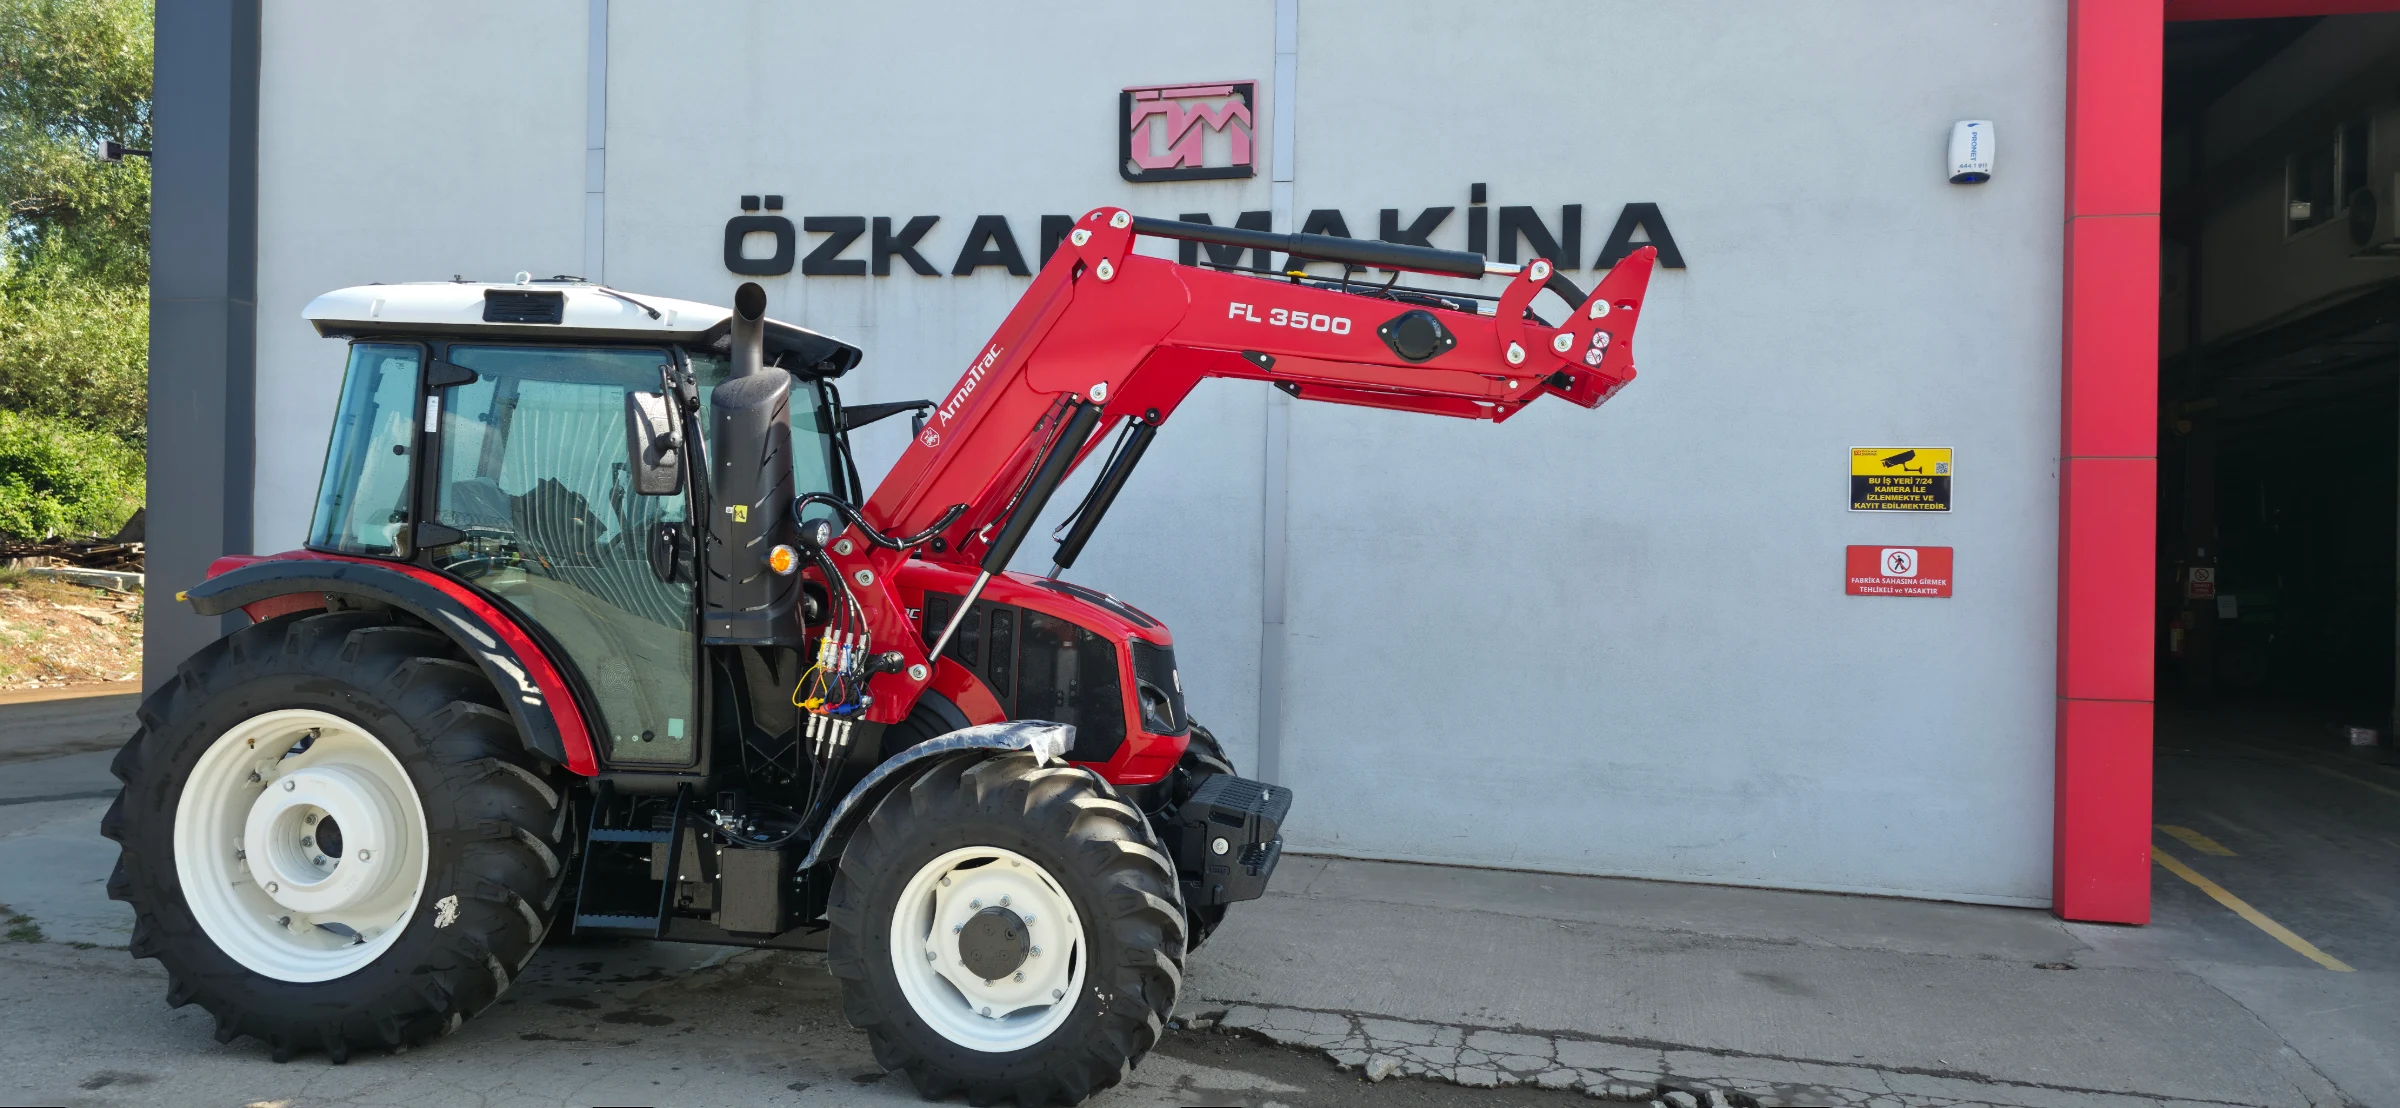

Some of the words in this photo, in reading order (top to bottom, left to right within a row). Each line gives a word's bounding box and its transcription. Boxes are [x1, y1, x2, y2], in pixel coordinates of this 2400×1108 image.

[1228, 301, 1262, 323] FL
[1269, 307, 1352, 335] 3500
[939, 343, 1002, 428] ArmaTrac
[1868, 477, 1881, 485] BU
[1883, 476, 1891, 486] İŞ
[1893, 476, 1913, 485] YERİ
[1915, 477, 1933, 485] 7/24
[1912, 485, 1926, 493] İLE
[1866, 493, 1920, 501] İZLENMEKTE
[1881, 502, 1947, 510] EDİLMEKTEDİR.
[1851, 576, 1880, 584] FABRİKA
[1881, 577, 1918, 585] SAHASINA
[1919, 577, 1947, 586] GİRMEK
[1859, 585, 1893, 593] TEHLİKELİ
[1904, 587, 1938, 595] YASAKTIR
